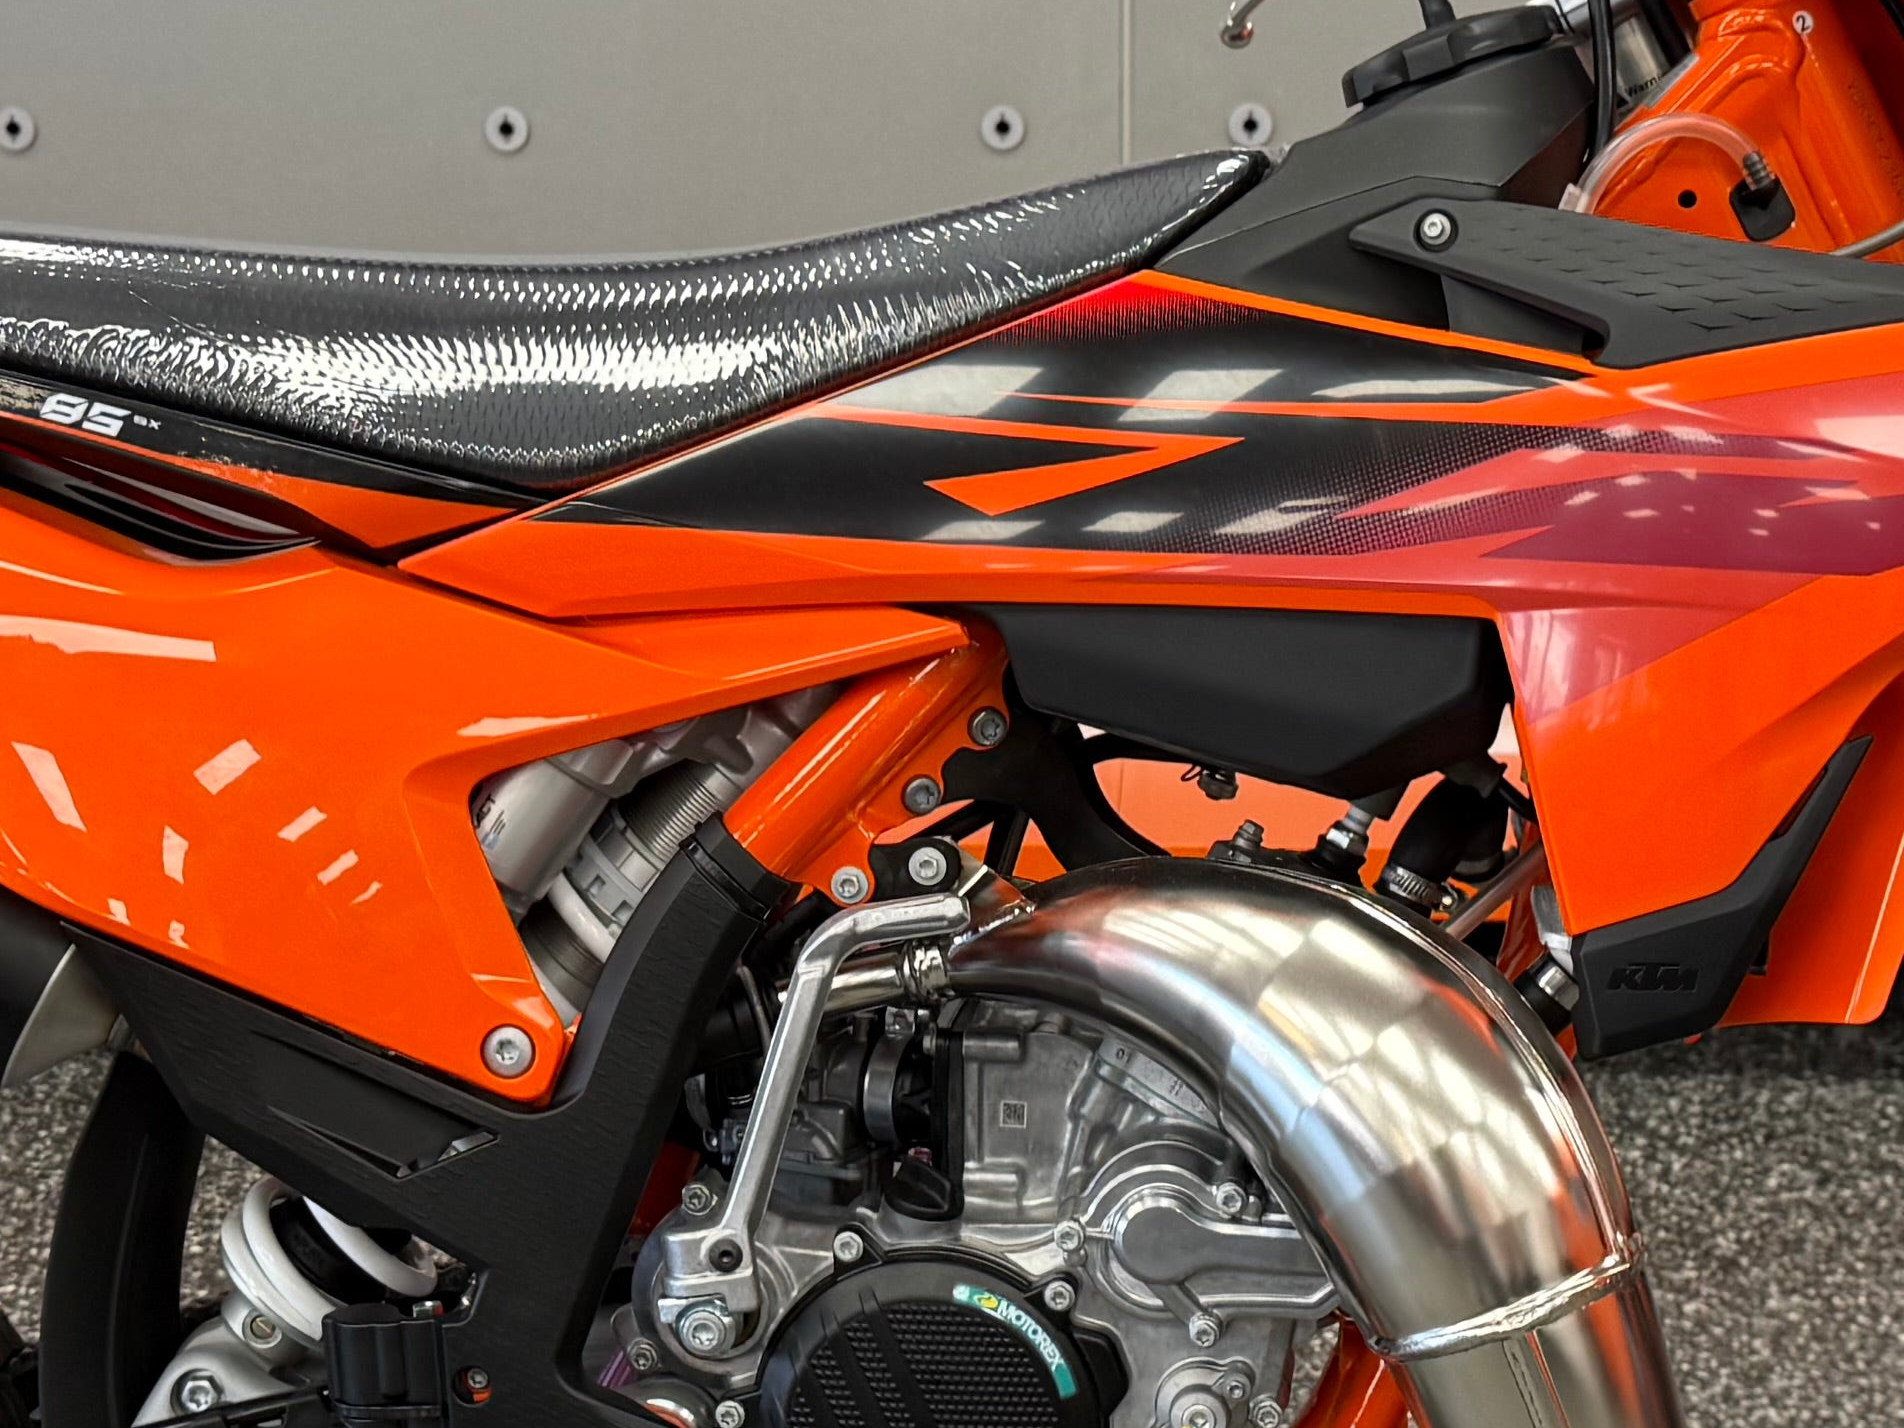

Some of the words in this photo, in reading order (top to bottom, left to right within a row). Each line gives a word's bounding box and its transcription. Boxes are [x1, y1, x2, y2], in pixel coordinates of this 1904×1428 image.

[1796, 14, 1811, 33] 2
[40, 393, 132, 437] 85
[1606, 963, 1699, 993] KTM
[997, 1300, 1065, 1373] MOTOREX
